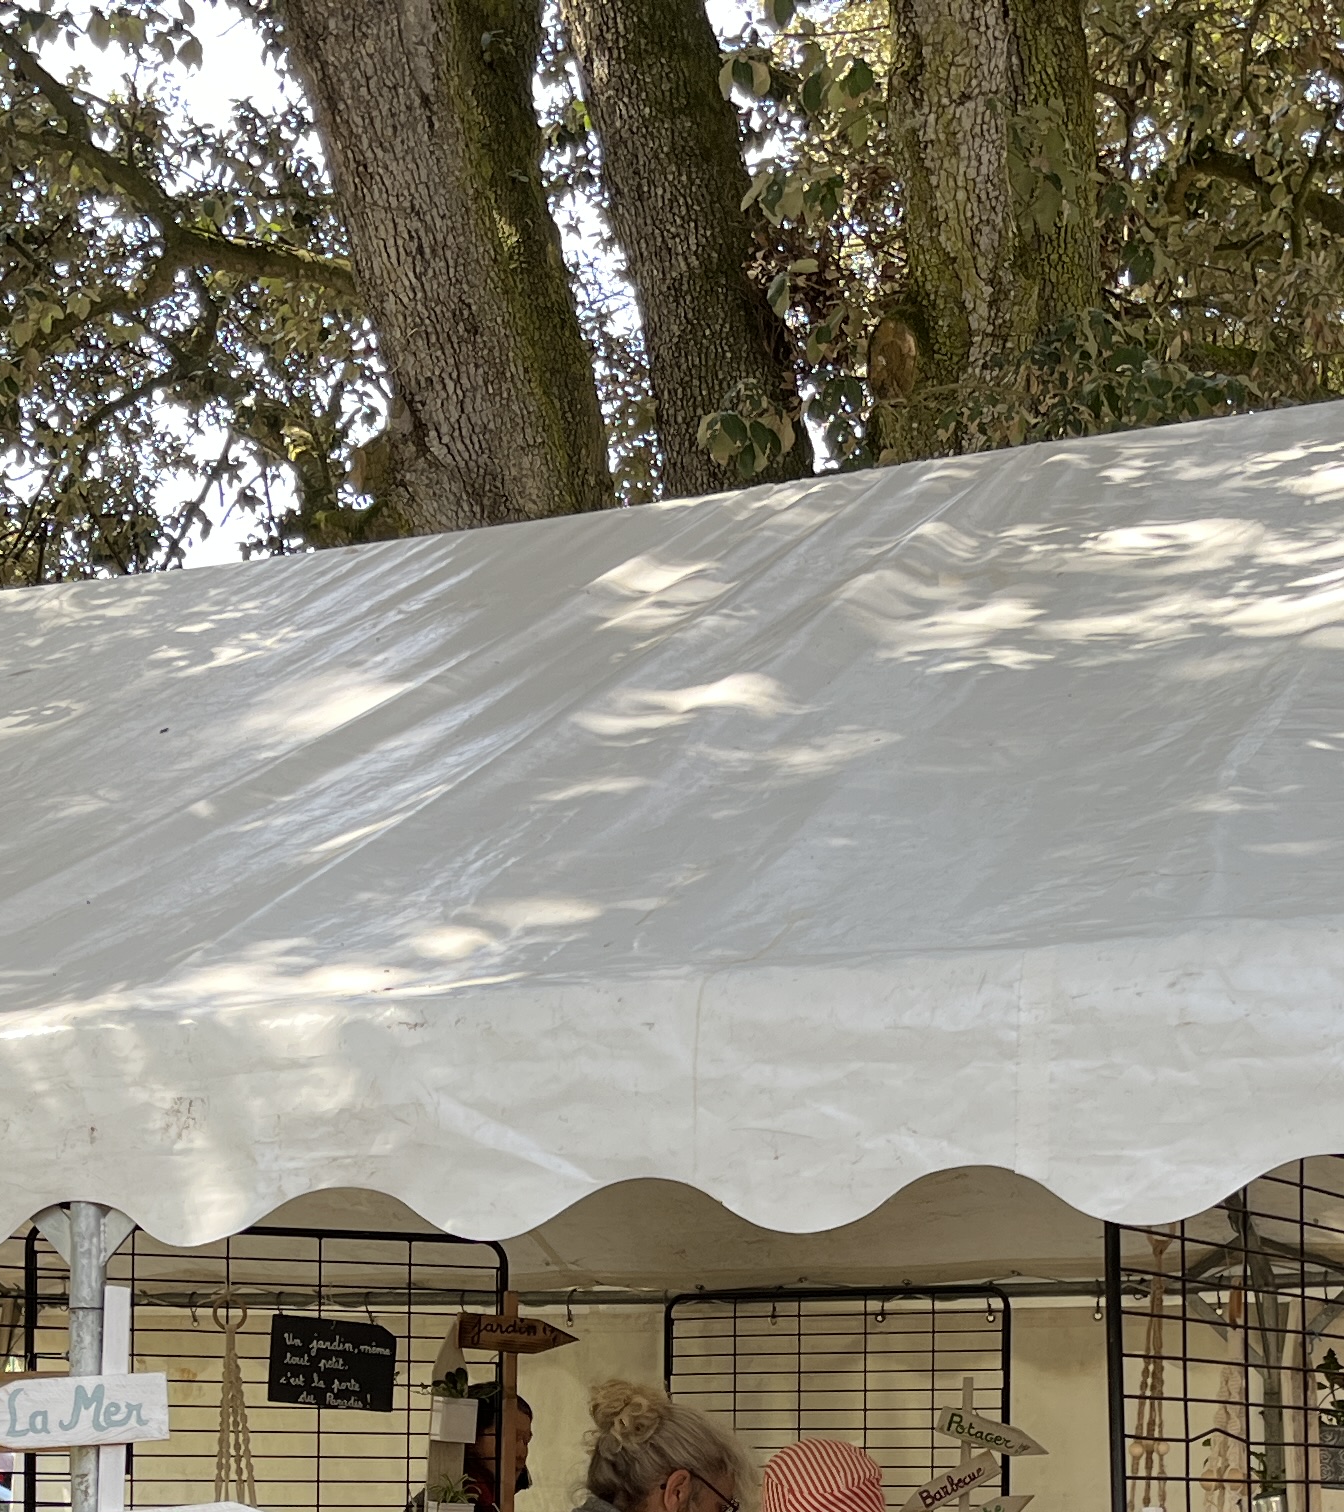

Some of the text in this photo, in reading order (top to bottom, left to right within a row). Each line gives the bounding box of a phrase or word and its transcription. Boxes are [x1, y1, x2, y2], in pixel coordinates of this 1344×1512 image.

[283, 1332, 303, 1347] Un
[283, 1352, 311, 1366] tout
[311, 1372, 326, 1389] la
[331, 1378, 361, 1394] porte
[5, 1383, 150, 1438] La Mer
[917, 1466, 987, 1510] Barbecue
